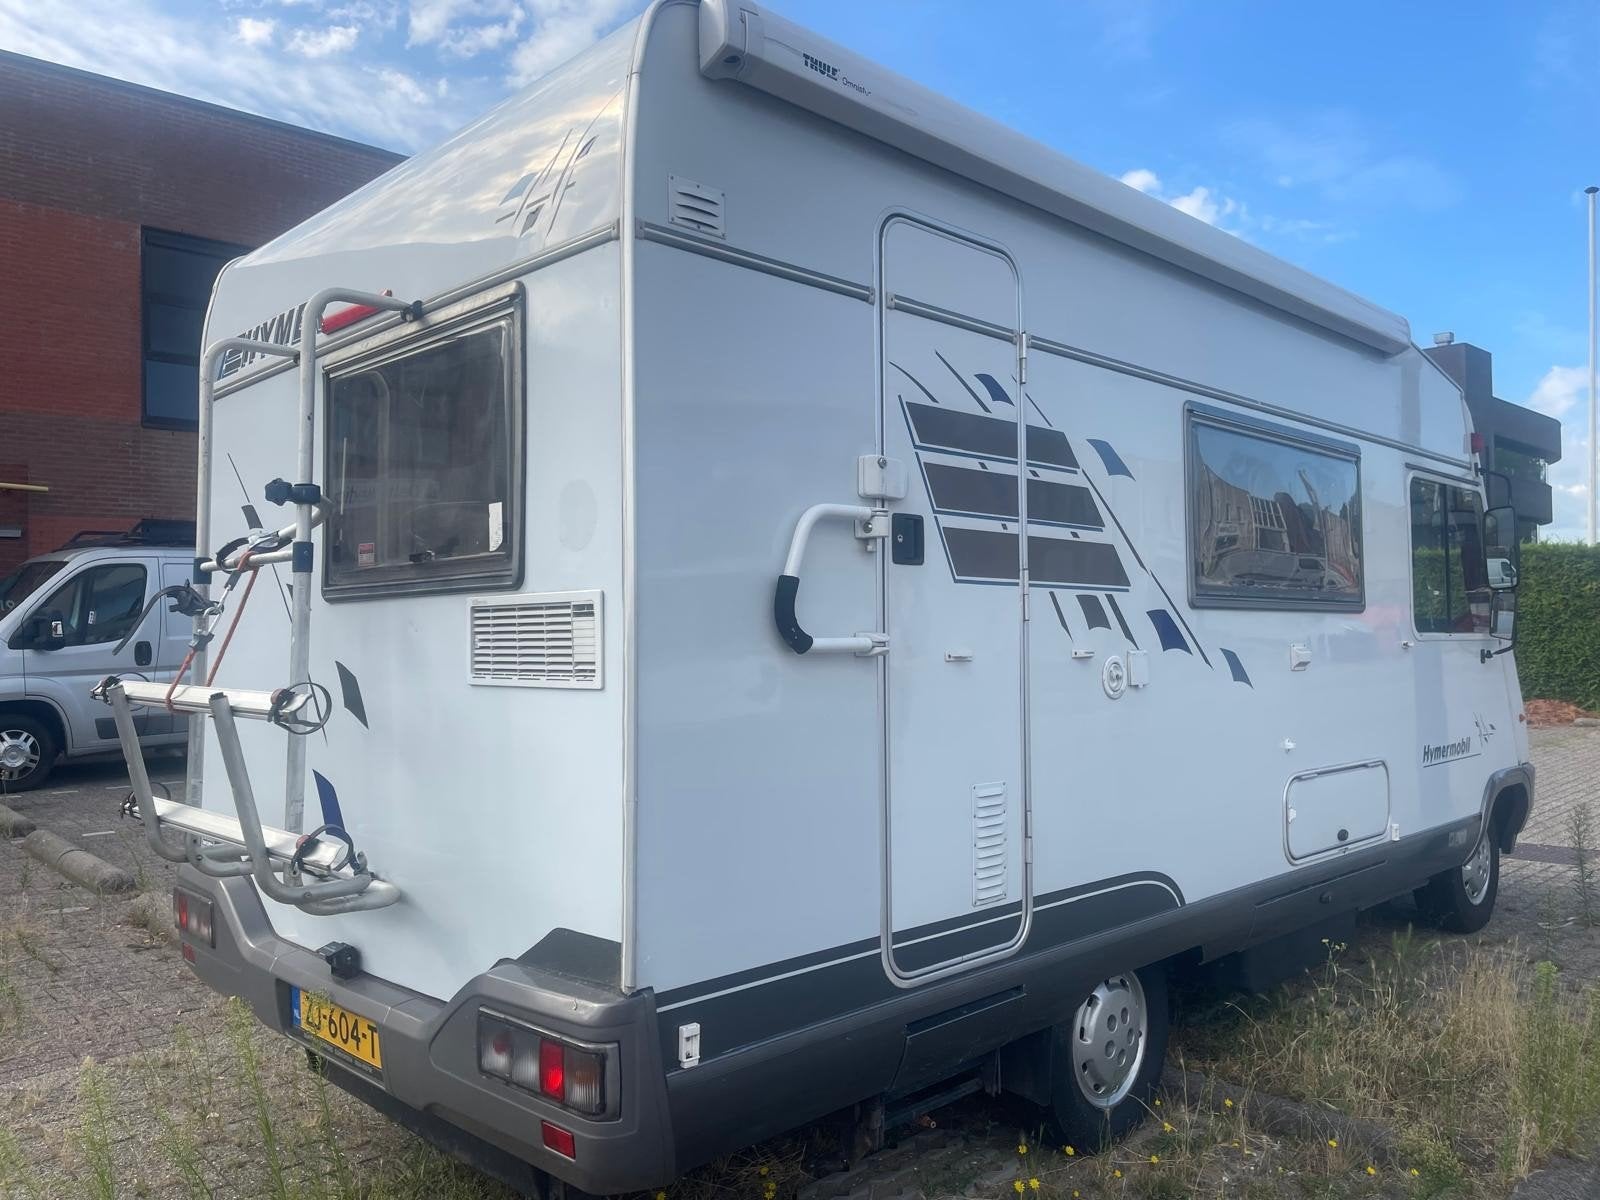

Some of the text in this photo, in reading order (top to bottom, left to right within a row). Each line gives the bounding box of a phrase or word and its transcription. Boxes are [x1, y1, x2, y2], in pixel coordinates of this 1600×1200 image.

[803, 53, 872, 97] THULE Omnist
[240, 298, 326, 369] HYME
[1423, 736, 1471, 763] Hymermobil
